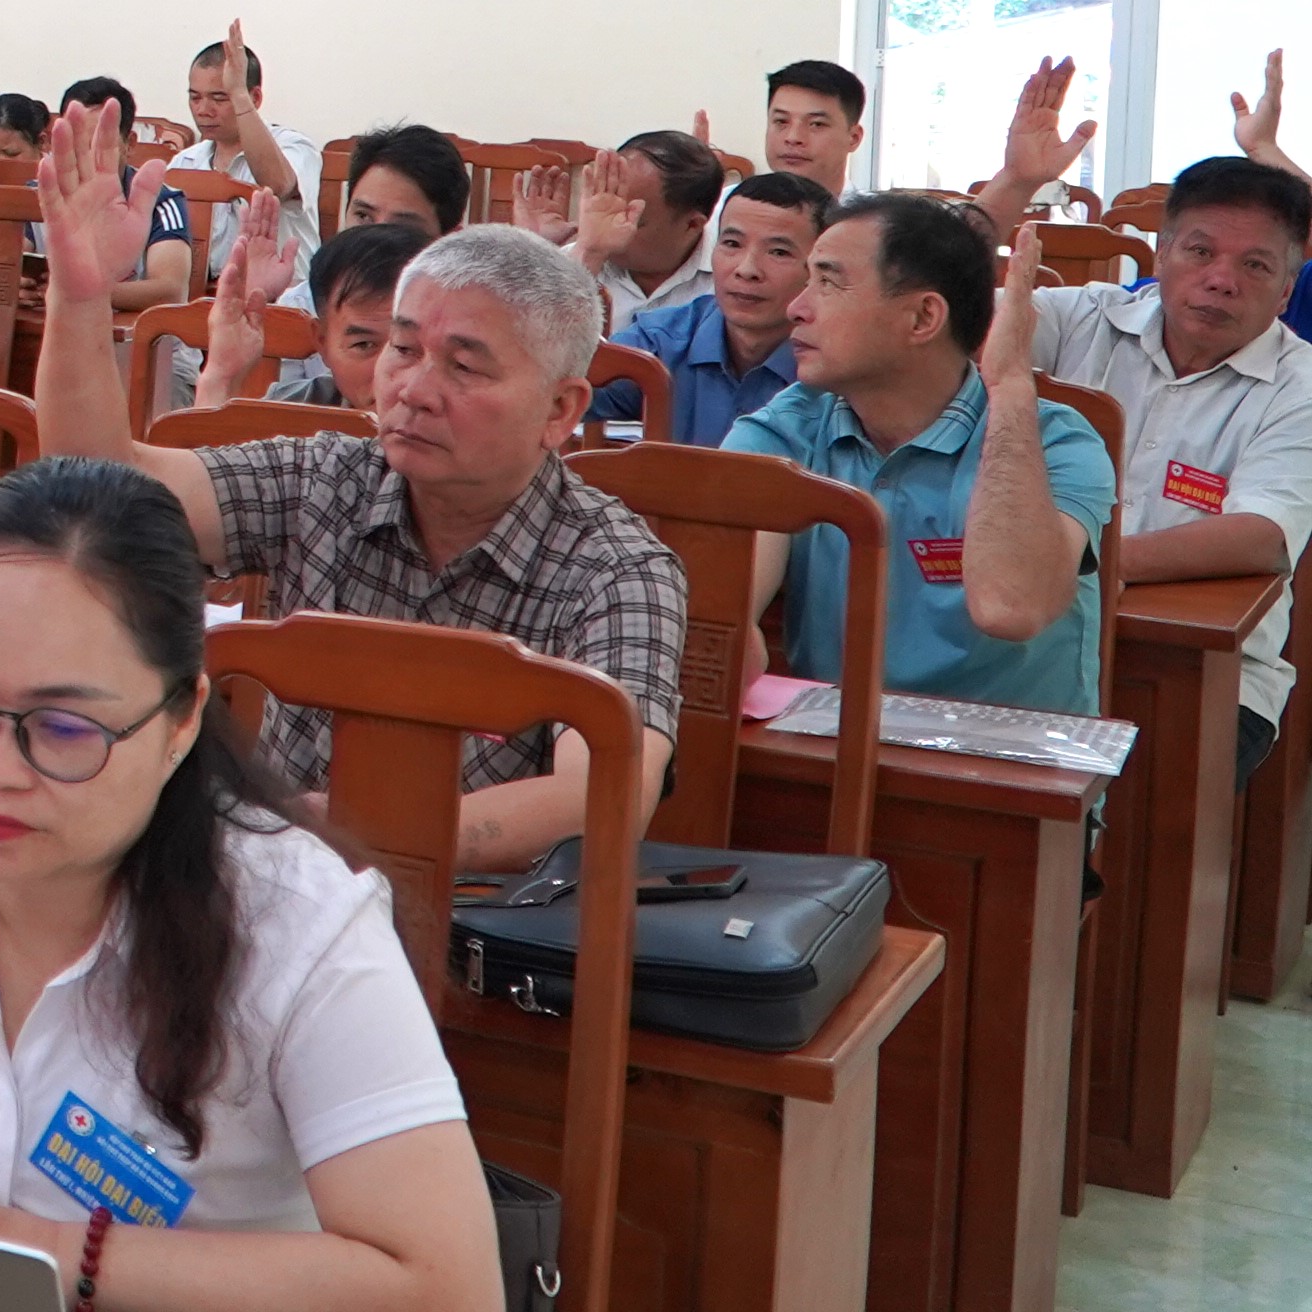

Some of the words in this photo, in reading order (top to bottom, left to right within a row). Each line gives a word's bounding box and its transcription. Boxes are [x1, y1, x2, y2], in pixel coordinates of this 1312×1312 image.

[49, 1134, 78, 1165] ĐẠI
[76, 1152, 105, 1186] HỘI
[101, 1176, 131, 1207] ĐẠI
